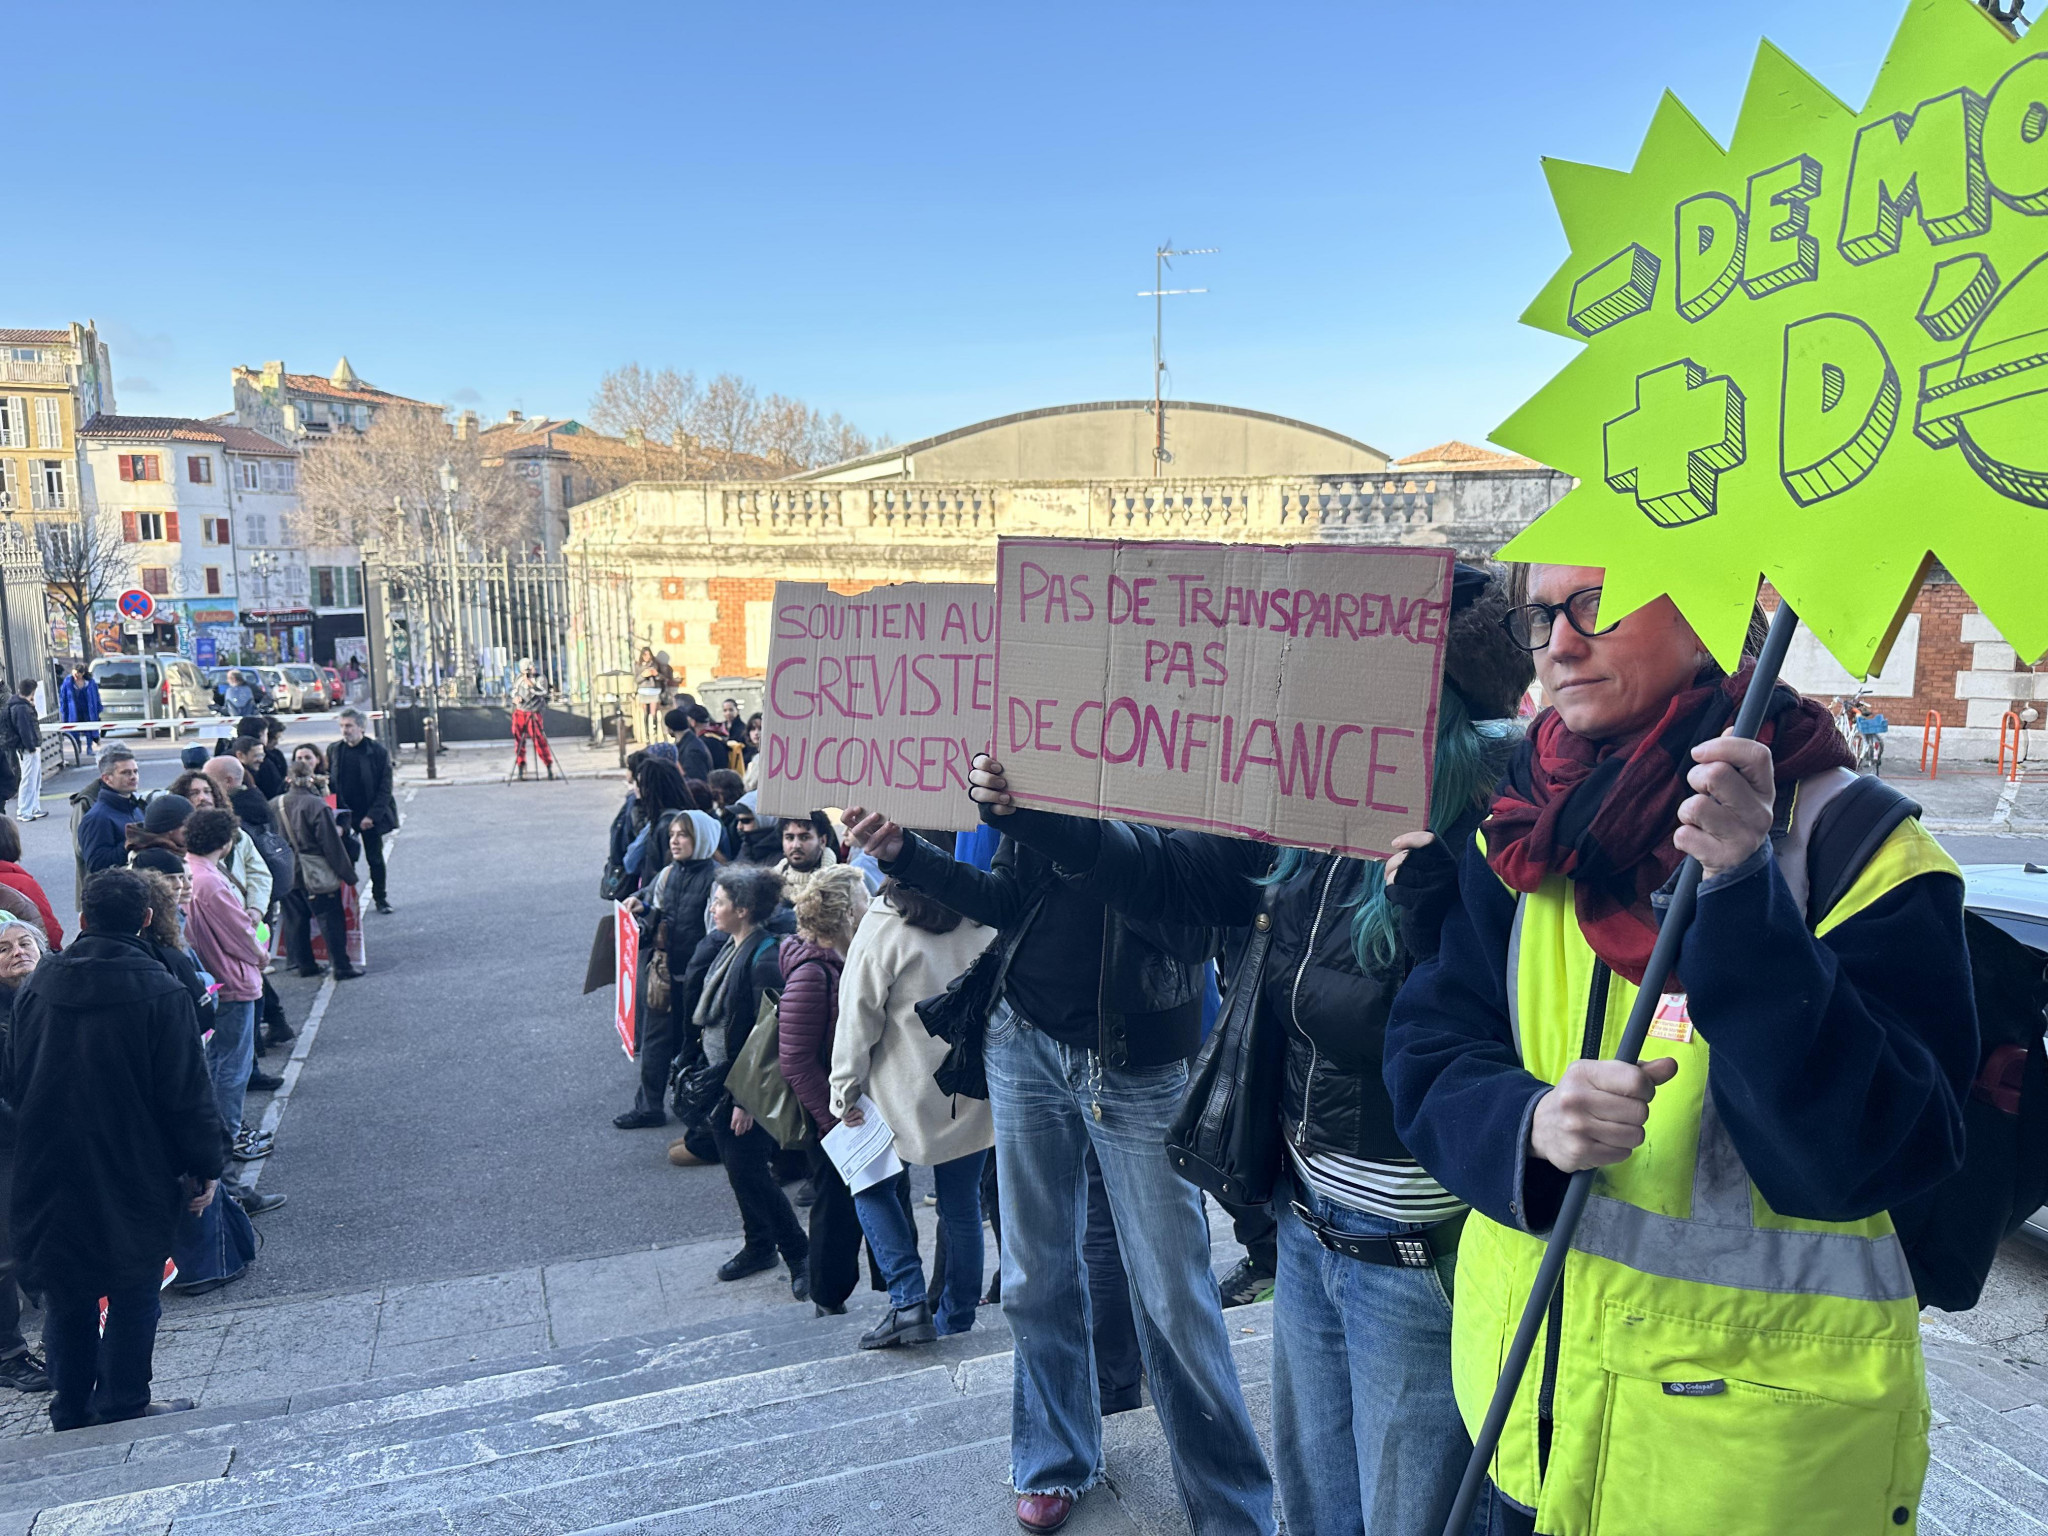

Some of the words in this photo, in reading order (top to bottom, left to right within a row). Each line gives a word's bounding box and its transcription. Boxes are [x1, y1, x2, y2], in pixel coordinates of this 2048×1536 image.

[777, 602, 926, 641] SOUTIEN
[941, 602, 994, 644] AU
[1020, 561, 1094, 624] PAS
[1107, 574, 1157, 625] DE
[1168, 574, 1450, 645] TRANSPARENCE
[770, 653, 994, 720] GREVISTE
[1145, 639, 1229, 688] PAS
[768, 733, 807, 781] DU
[1009, 696, 1061, 753] DE
[1071, 696, 1415, 814] CONFIANCE
